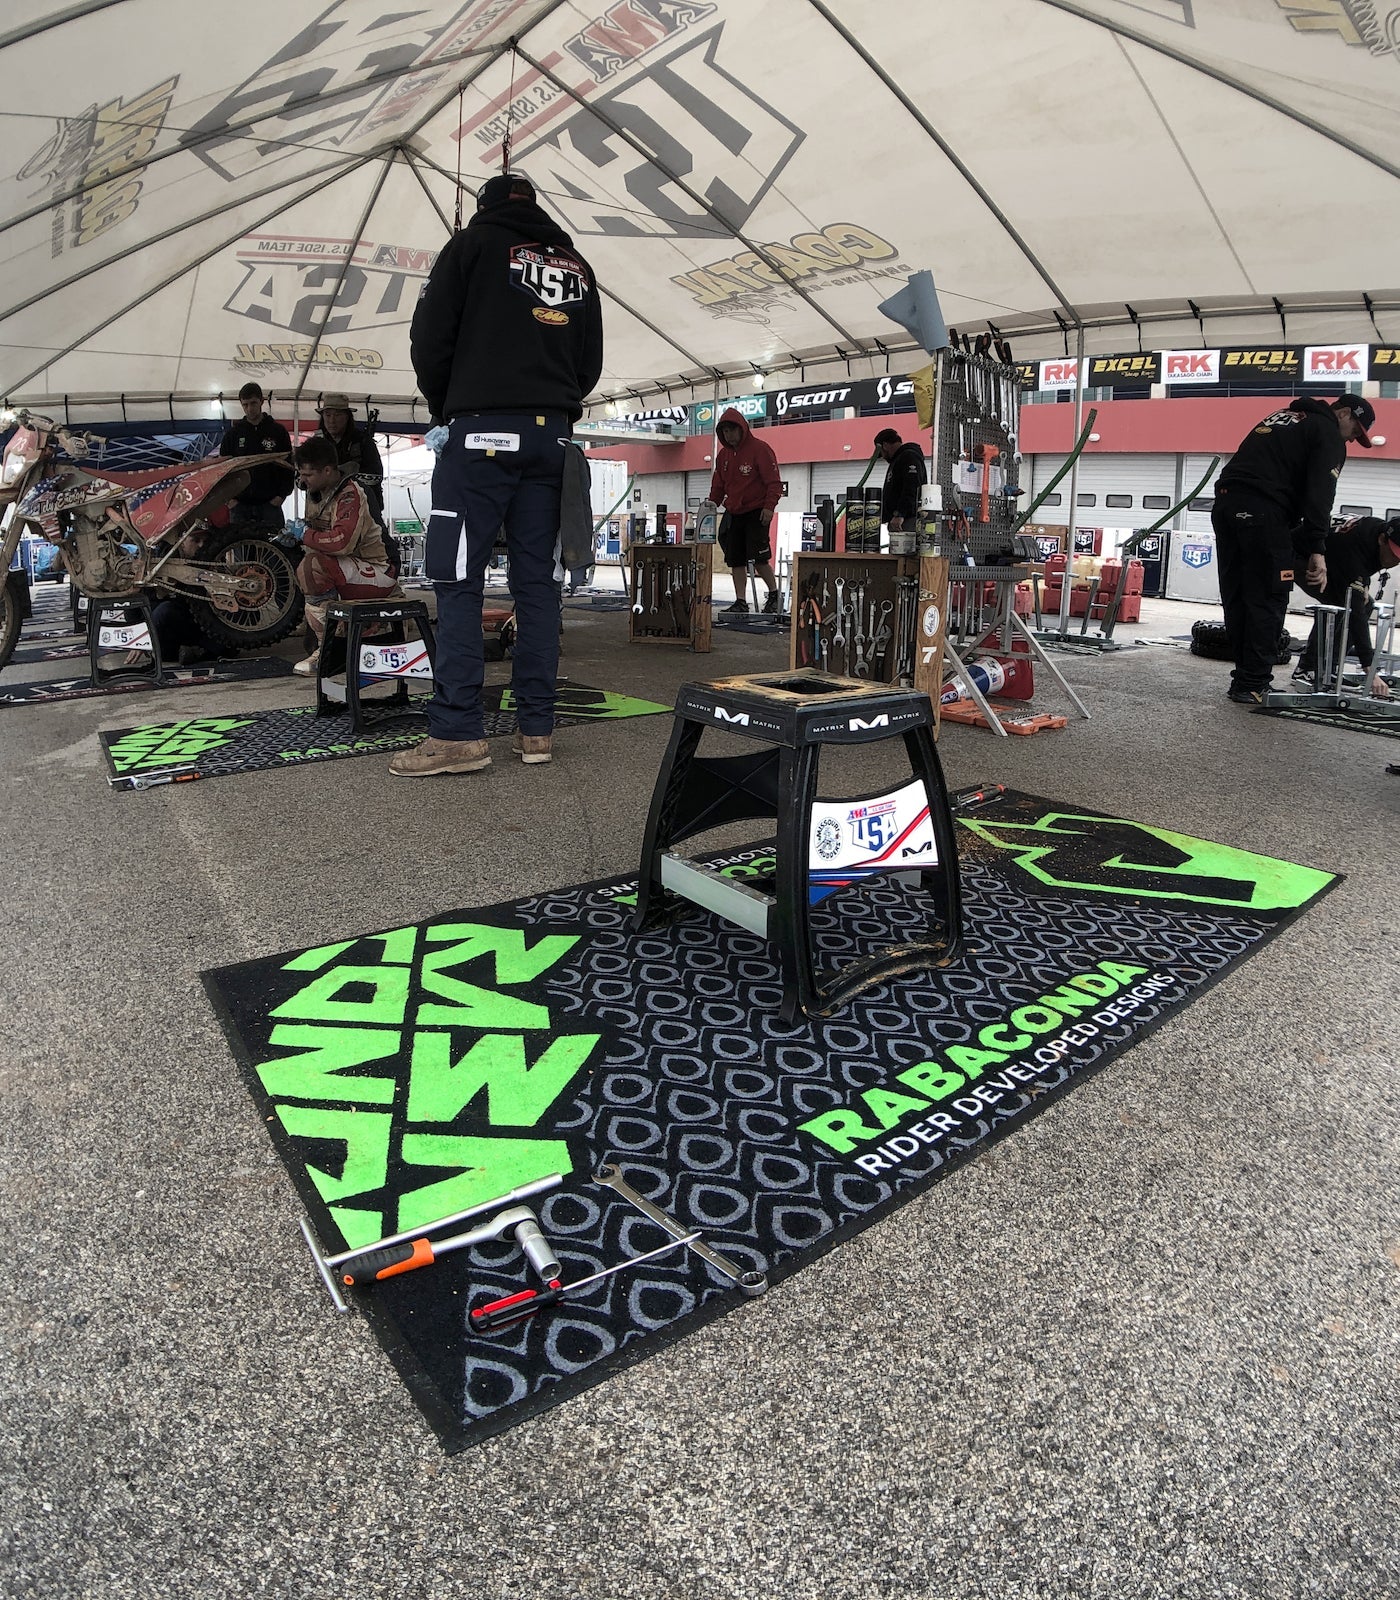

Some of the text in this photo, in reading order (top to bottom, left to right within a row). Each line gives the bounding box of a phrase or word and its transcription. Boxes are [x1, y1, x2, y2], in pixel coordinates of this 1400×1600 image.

[522, 263, 584, 304] USA
[1093, 356, 1157, 373] EXCEL
[1168, 354, 1213, 373] RK
[1224, 351, 1300, 366] EXCEL
[1311, 351, 1360, 370] RK
[788, 388, 851, 406] SCOTT
[175, 488, 193, 507] 23
[1187, 550, 1210, 568] USA
[921, 646, 937, 664] 7
[687, 702, 711, 713] MATRIX
[752, 720, 781, 730] MATRIX
[813, 724, 845, 733] MATRIX
[892, 712, 920, 721] MATRIX
[816, 819, 840, 841] MISSOURI
[848, 813, 899, 852] USA
[796, 960, 1150, 1154] RABACONDA
[854, 972, 1176, 1177] RIDER DEVELOPED DESIGNS
